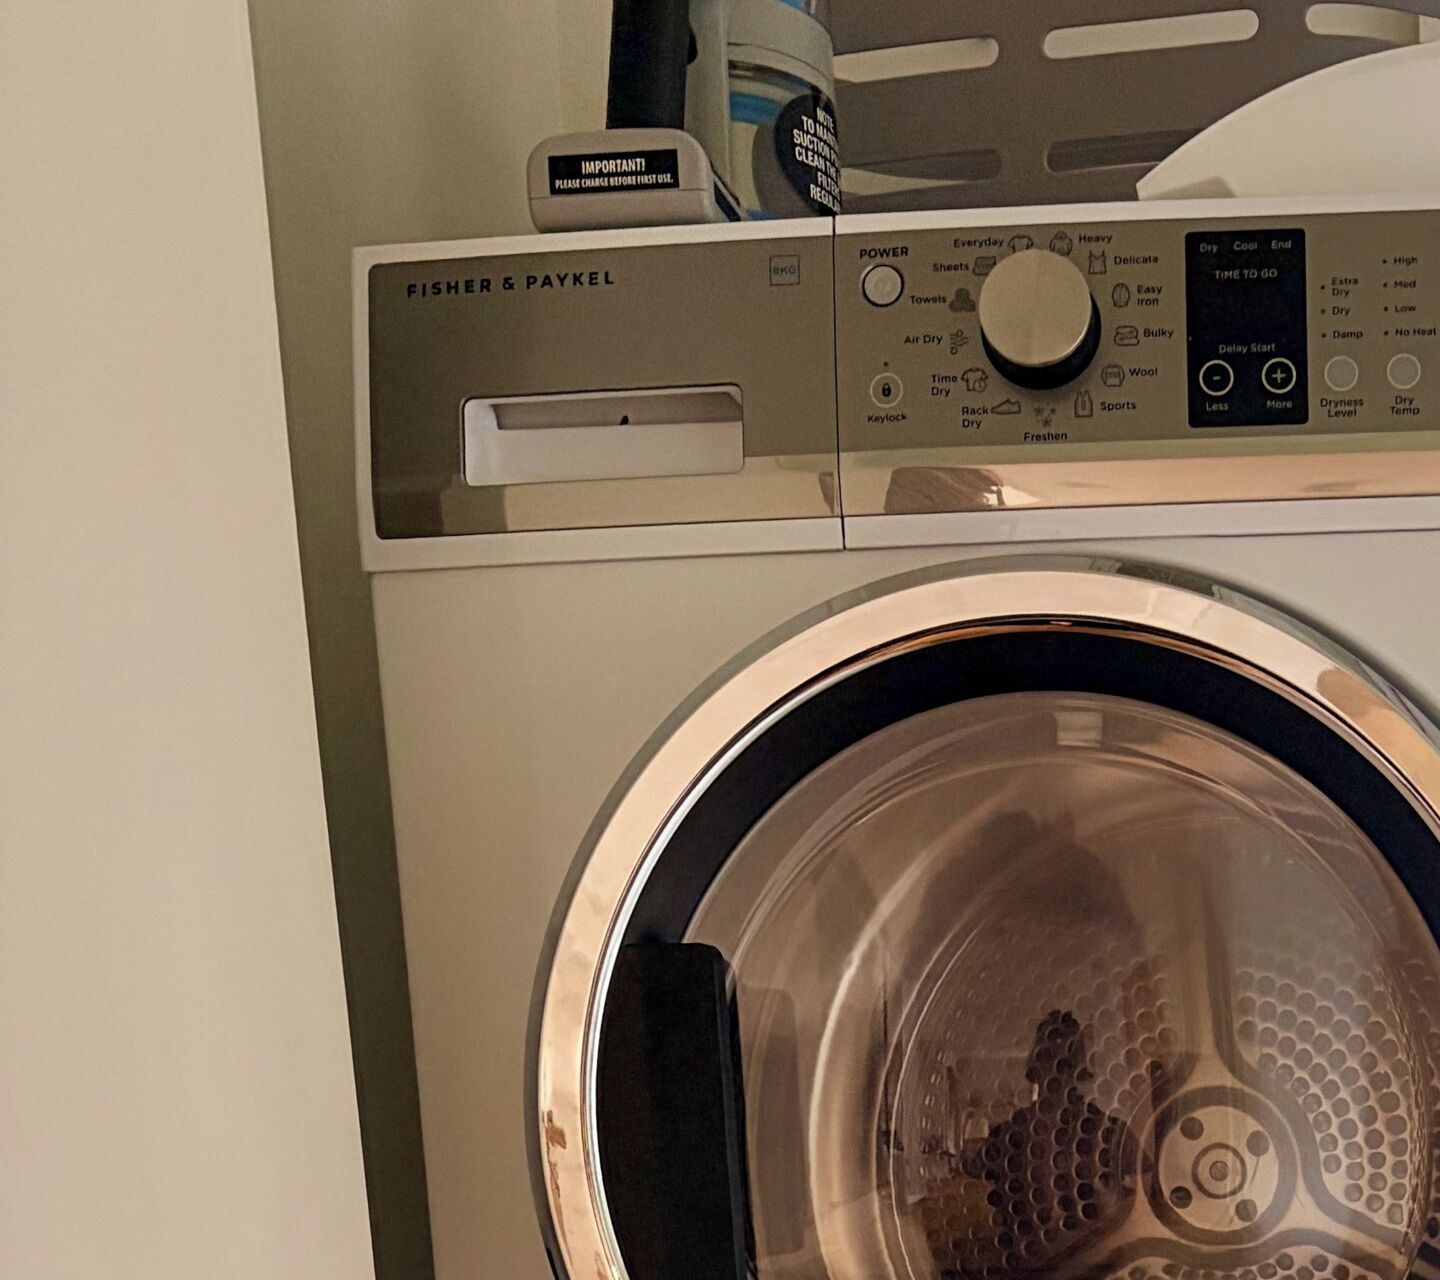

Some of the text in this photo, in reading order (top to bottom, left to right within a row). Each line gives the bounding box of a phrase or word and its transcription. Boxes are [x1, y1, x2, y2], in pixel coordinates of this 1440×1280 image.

[801, 115, 815, 134] TO
[793, 128, 831, 159] SUCTION
[794, 146, 825, 172] CLEAN
[581, 158, 645, 175] IMPORTANT!
[555, 179, 580, 189] PLEASE
[581, 177, 608, 188] CHARGE
[609, 175, 636, 187] BEFORE
[637, 174, 656, 185] FIRST
[953, 237, 1004, 248] Everyday
[1078, 233, 1113, 245] Heavy
[1200, 240, 1292, 253] Dry End
[859, 246, 909, 259] POWER
[1114, 254, 1159, 266] Delicate
[1393, 256, 1418, 266] High
[932, 262, 970, 273] Sheets
[1214, 268, 1258, 280] TIME TO
[407, 271, 615, 298] FISHER & PAYKEL
[1331, 277, 1359, 286] Extra
[1137, 284, 1162, 295] Easy
[1332, 287, 1350, 298] Dry
[910, 295, 947, 304] Towels
[1332, 306, 1350, 316] Dry
[1394, 304, 1417, 313] Low
[1143, 327, 1174, 339] Bulky
[1332, 330, 1364, 340] Damp
[904, 334, 943, 345] Air Dry
[1250, 342, 1276, 353] Start
[1129, 367, 1158, 378] Wool
[932, 373, 958, 384] Time
[931, 387, 951, 397] Dry
[1099, 400, 1137, 412] Sports
[1266, 400, 1293, 409] More
[1320, 398, 1364, 409] Dryness
[1395, 395, 1414, 406] Dry
[961, 405, 991, 416] Rack
[1205, 402, 1229, 411] Less
[1390, 406, 1421, 416] Temp
[867, 411, 908, 423] Keylock
[1327, 407, 1357, 418] Level
[962, 419, 982, 429] Dry
[1024, 432, 1068, 442] Freshen
